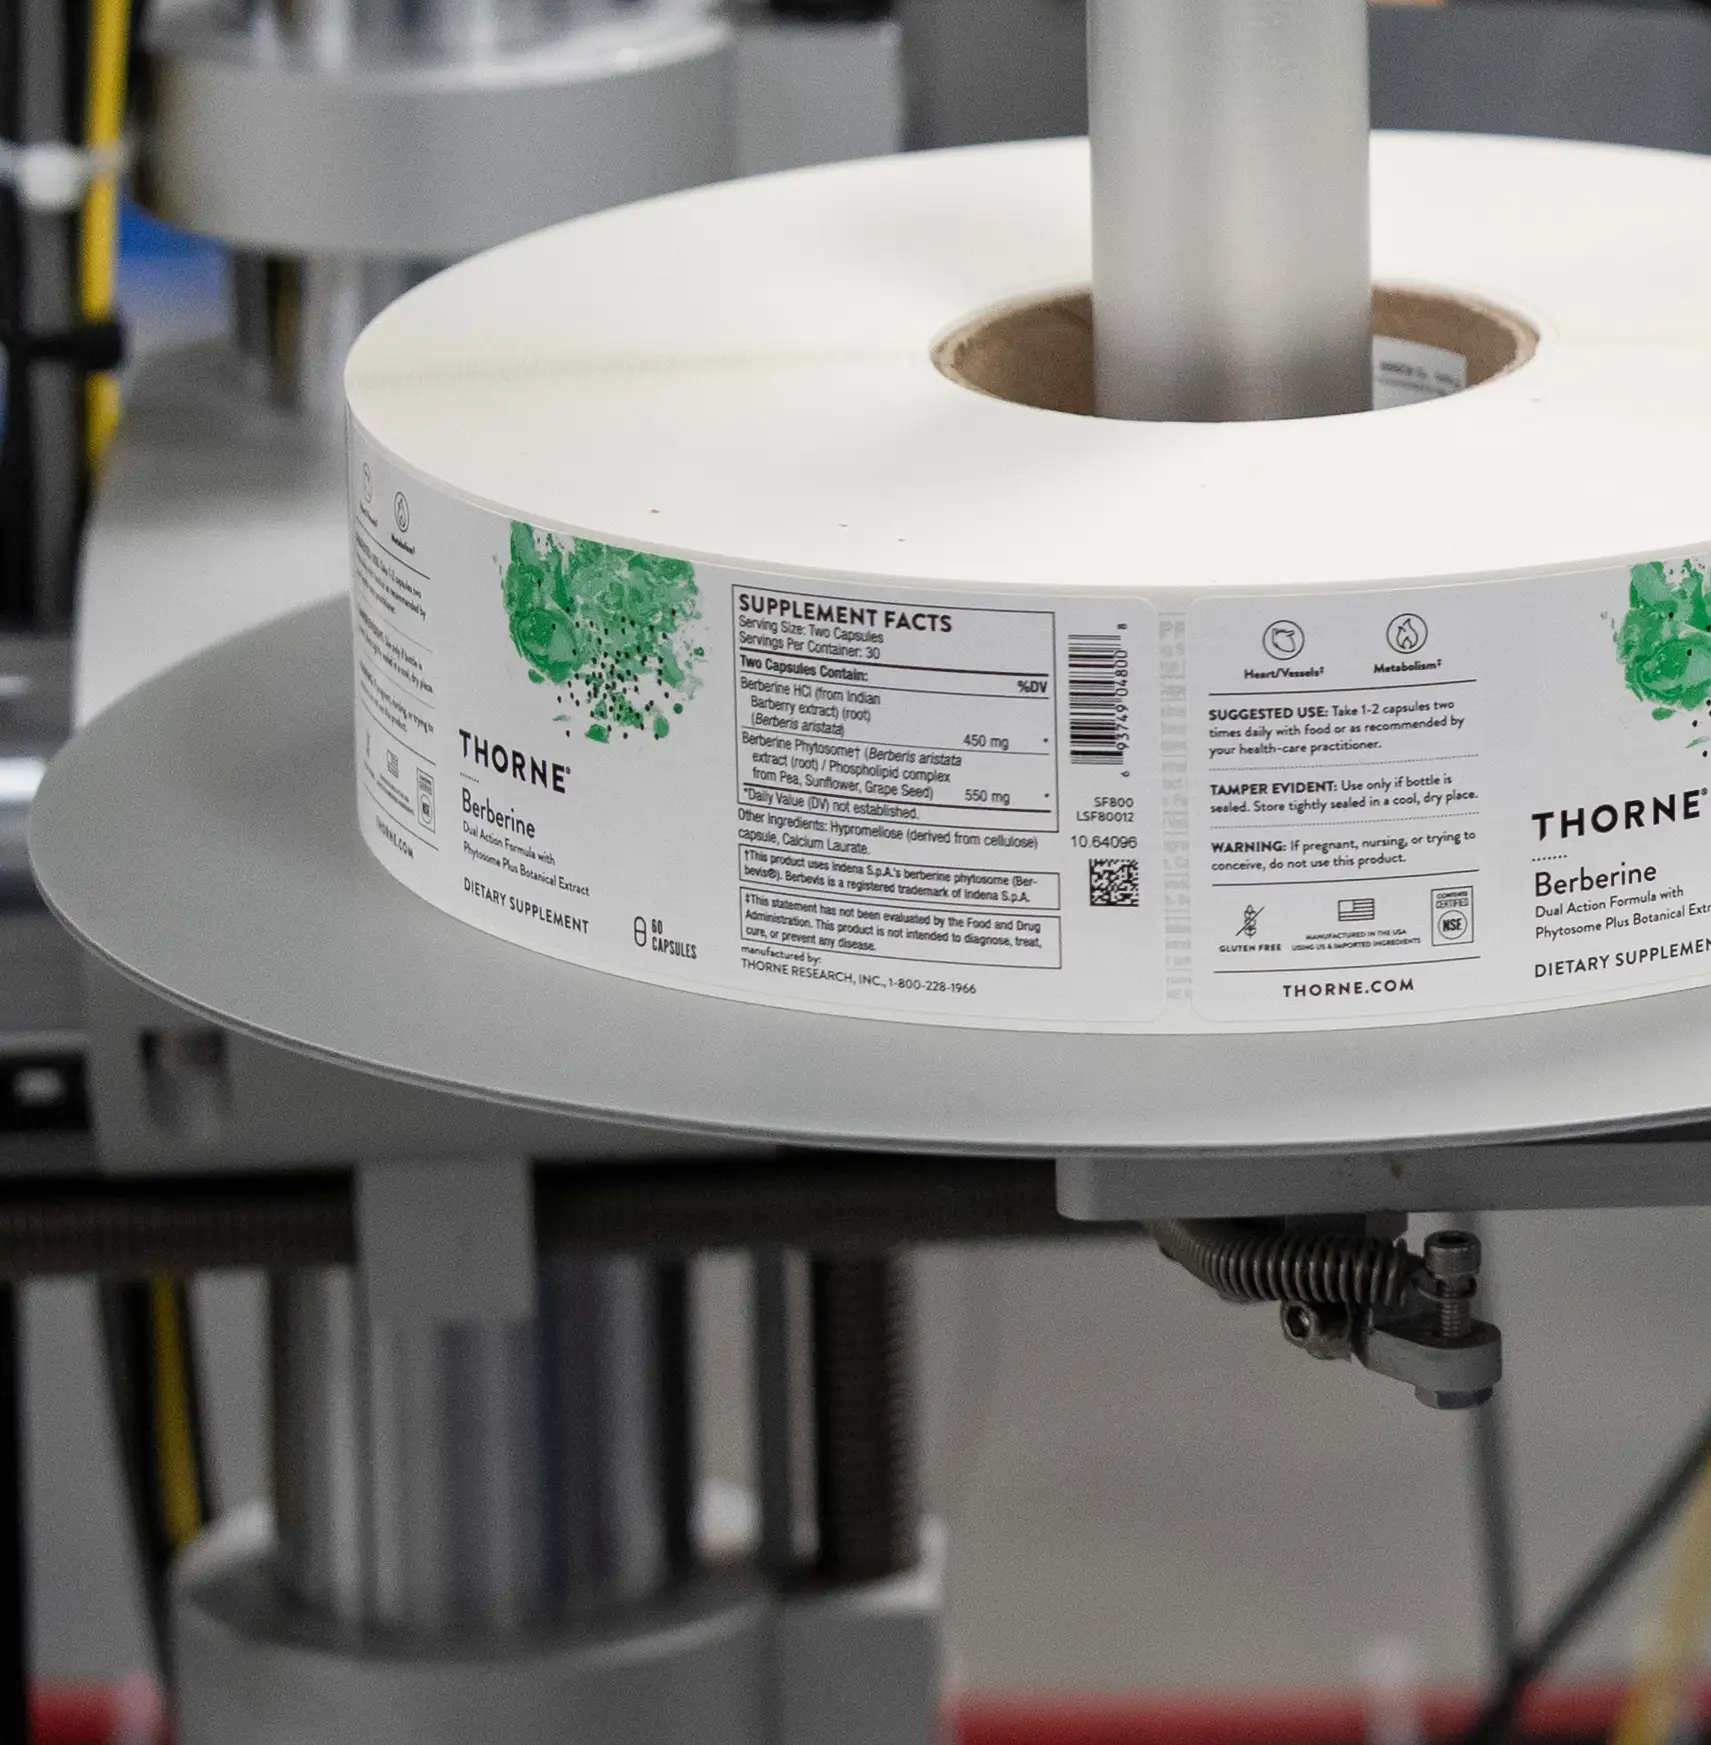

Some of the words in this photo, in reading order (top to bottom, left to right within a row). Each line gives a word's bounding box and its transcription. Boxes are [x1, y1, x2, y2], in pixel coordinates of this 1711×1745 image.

[739, 593, 878, 628] SUPPLEMENT
[884, 611, 952, 633] FACTS
[739, 615, 777, 634] Serving
[781, 620, 807, 635] Size:
[809, 623, 831, 637] Two
[833, 626, 884, 643] Capsules
[739, 631, 784, 651] Servings
[787, 637, 805, 651] Per
[808, 640, 862, 658] Container:
[866, 646, 881, 659] 30
[740, 655, 762, 670] Two
[765, 659, 816, 677] Capsules
[819, 665, 869, 682] Contain:
[1116, 649, 1129, 697] 04800
[740, 677, 790, 696] Berberine
[815, 686, 844, 701] (from
[846, 690, 881, 704] Indian
[1017, 679, 1048, 694] %DV
[751, 695, 796, 716] Barberry
[799, 703, 839, 720] extract)
[842, 706, 871, 724] (root)
[1209, 708, 1293, 720] SUGGESTED
[1297, 706, 1329, 718] USE:
[1332, 705, 1358, 717] Take
[1360, 703, 1379, 715] 1-2
[1383, 701, 1430, 716] capsules
[1434, 699, 1454, 710] two
[751, 712, 799, 730] (Berberis
[801, 720, 845, 737] aristata)
[1116, 703, 1130, 751] 93749
[1209, 727, 1241, 738] times
[1245, 725, 1272, 740] daily
[1275, 724, 1300, 736] with
[1304, 723, 1331, 735] food
[1334, 726, 1348, 734] or
[1350, 725, 1361, 733] as
[1364, 715, 1447, 732] recommended
[1450, 714, 1465, 729] by
[742, 732, 792, 750] Berberine
[864, 746, 916, 763] (Berberis
[918, 752, 962, 767] aristata
[963, 734, 987, 747] 450
[990, 738, 1009, 751] mg
[1209, 747, 1236, 758] your
[1239, 742, 1307, 754] health-care
[1310, 739, 1382, 756] practitioner.
[752, 752, 788, 767] extract
[791, 756, 819, 773] (root)
[829, 760, 899, 781] Phospholipid
[903, 769, 951, 784] complex
[753, 767, 777, 782] from
[779, 771, 802, 788] Pea,
[805, 774, 862, 795] Sunflower,
[865, 781, 898, 798] Grape
[901, 784, 934, 800] Seed)
[1210, 784, 1268, 796] TAMPER
[1272, 781, 1338, 794] EVIDENT:
[1341, 780, 1363, 792] Use
[1366, 778, 1391, 793] only
[1394, 777, 1403, 789] if
[1406, 775, 1440, 788] bottle
[1443, 774, 1452, 785] is
[776, 793, 804, 808] Value
[808, 797, 830, 814] (DV)
[832, 801, 850, 814] not
[853, 803, 920, 820] established.
[964, 789, 987, 802] 550
[991, 794, 1010, 806] mg
[1093, 797, 1134, 808] SF800
[1210, 801, 1250, 813] sealed.
[1253, 801, 1285, 812] Store
[1288, 799, 1327, 814] tightly
[1330, 796, 1366, 809] sealed
[1369, 796, 1380, 807] in
[1383, 798, 1390, 806] a
[1393, 793, 1420, 806] cool,
[1423, 792, 1442, 806] dry
[1445, 790, 1478, 805] place.
[461, 787, 536, 839] Berberine
[462, 819, 478, 837] Dual
[479, 831, 503, 848] Action
[504, 838, 536, 860] Formula
[537, 851, 556, 865] with
[738, 808, 765, 824] Other
[767, 812, 827, 832] Ingredients:
[830, 820, 903, 840] Hypromellose
[906, 828, 951, 844] (derived
[954, 832, 980, 846] from
[983, 835, 1038, 851] cellulose)
[738, 829, 780, 846] capsule,
[782, 833, 824, 850] Calcium
[826, 838, 870, 855] Laurate.
[1071, 835, 1138, 849] 10.64096
[1211, 841, 1287, 853] WARNING:
[1302, 838, 1359, 854] pregnant,
[1361, 835, 1408, 850] nursing,
[1411, 837, 1423, 845] or
[1427, 831, 1461, 847] trying
[1464, 830, 1476, 841] to
[463, 840, 501, 867] Phytosome
[502, 857, 518, 874] Plus
[519, 863, 557, 886] Botanical
[558, 876, 590, 897] Extract
[1211, 859, 1266, 872] conceive,
[1269, 858, 1283, 869] do
[1287, 857, 1306, 869] not
[1310, 859, 1330, 868] use
[1333, 855, 1354, 866] this
[1358, 851, 1407, 869] product.
[1535, 861, 1657, 897] Berberine
[464, 876, 506, 907] DIETARY
[509, 896, 589, 934] SUPPLEMENT
[1535, 904, 1564, 918] Dual
[1566, 900, 1606, 915] Action
[1609, 892, 1656, 909] Formula
[1659, 886, 1684, 900] with
[651, 918, 663, 935] 60
[1535, 920, 1602, 942] Phytosome
[1605, 916, 1630, 930] Plus
[1633, 906, 1685, 925] Botanical
[651, 936, 697, 959] CAPSULES
[804, 952, 822, 965] by:
[1219, 945, 1256, 953] GLUTEN
[1258, 943, 1282, 952] FREE
[741, 958, 788, 975] THORNE
[791, 965, 856, 985] RESEARCH,
[889, 976, 976, 994] 1-800-228-1966
[1534, 954, 1609, 978] DIETARY
[1283, 978, 1415, 998] THORNE.COM
